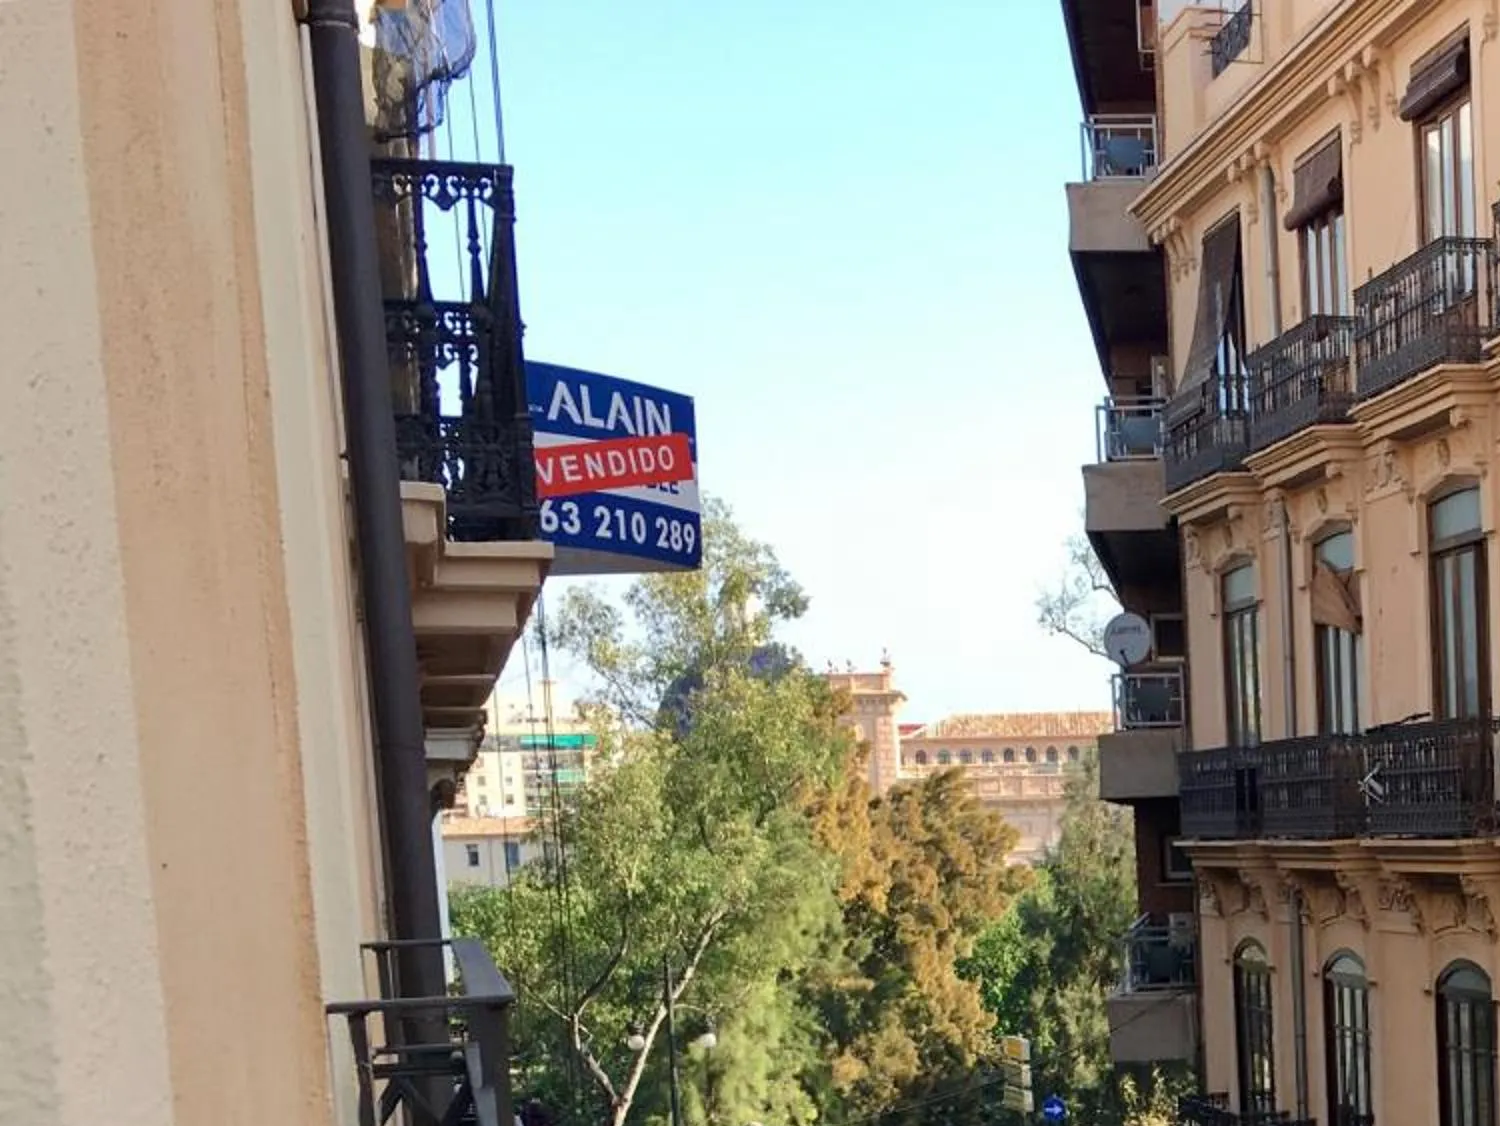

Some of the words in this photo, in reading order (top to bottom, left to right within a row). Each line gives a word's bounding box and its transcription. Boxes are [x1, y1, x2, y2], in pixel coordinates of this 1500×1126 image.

[548, 380, 673, 437] ALAIN
[536, 445, 674, 485] VENDIDO
[594, 506, 647, 544] 210
[655, 517, 695, 553] 289
